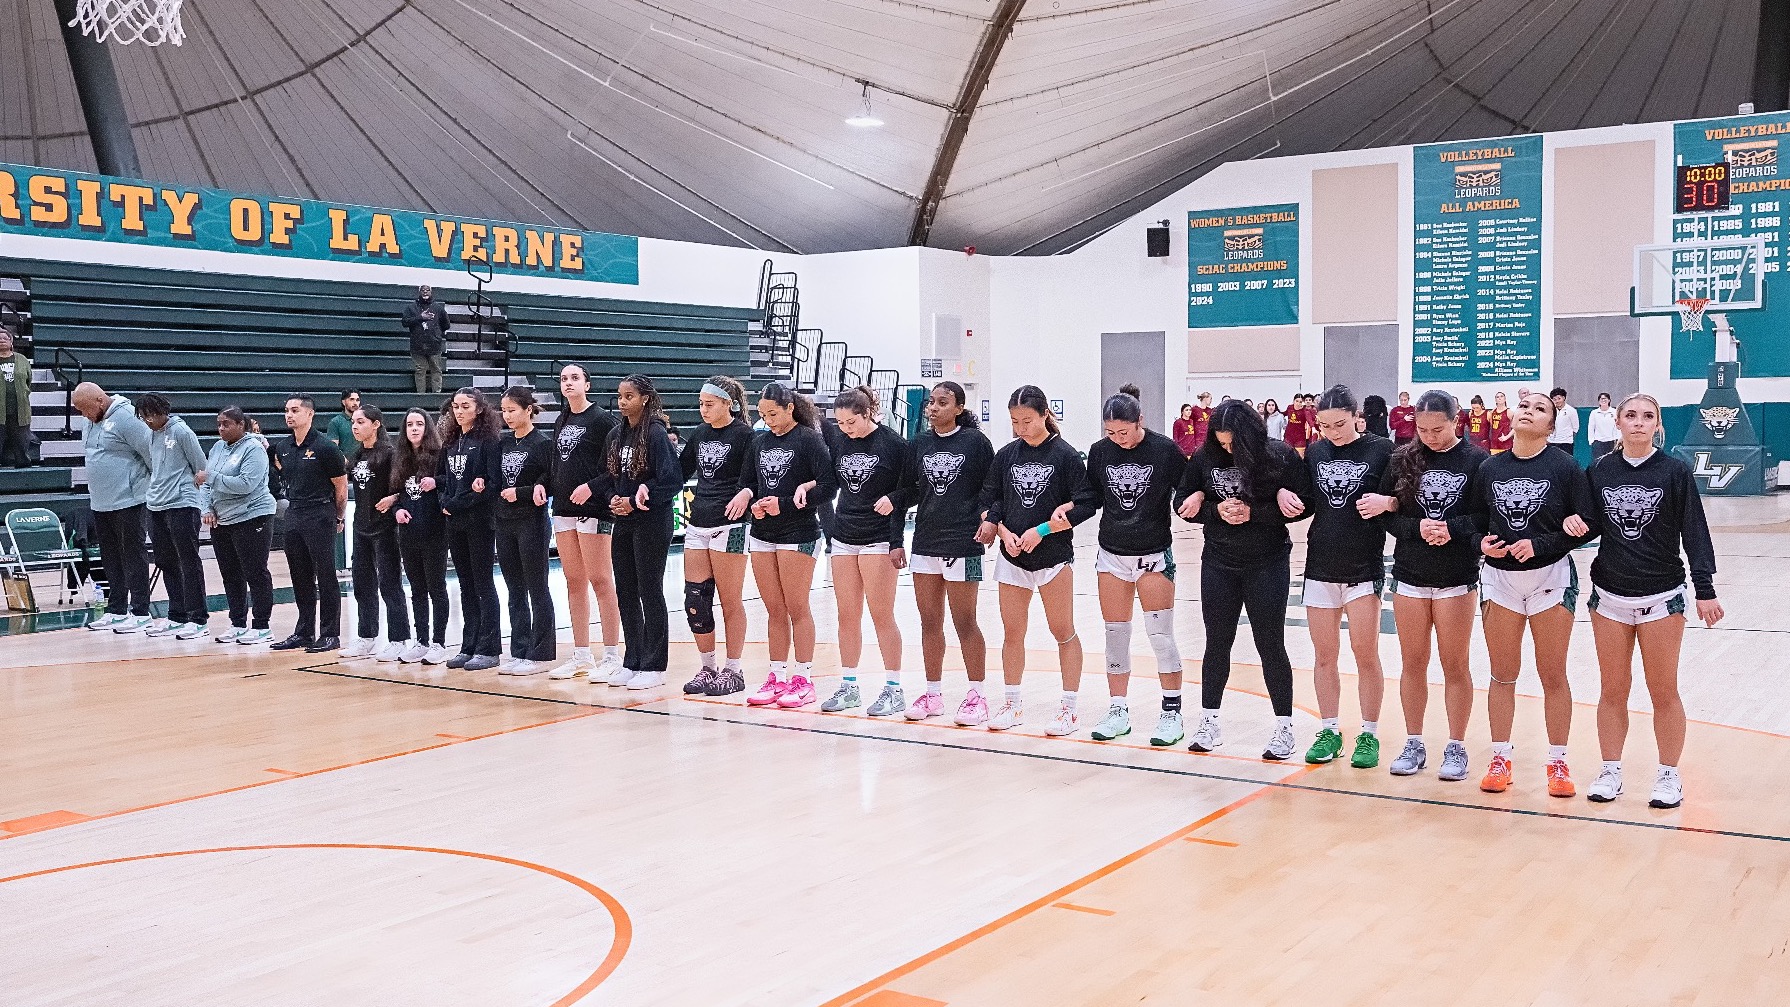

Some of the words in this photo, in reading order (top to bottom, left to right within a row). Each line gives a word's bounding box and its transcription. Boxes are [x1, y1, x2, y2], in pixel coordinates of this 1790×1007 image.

[1440, 147, 1515, 163] VOLLEYBALL
[1687, 167, 1725, 182] 10:00
[1731, 165, 1777, 178] EOPARDS
[1455, 186, 1500, 198] LEOPARDS
[1683, 182, 1718, 208] 30
[1440, 203, 1463, 213] ALL
[1466, 198, 1521, 211] AMERICA
[1751, 201, 1780, 213] 1981
[1190, 216, 1233, 228] WOMEN'S
[1236, 212, 1296, 225] BASKETBALL
[1713, 219, 1742, 230] 1985
[230, 197, 302, 247] OF
[329, 208, 401, 255] LA
[424, 219, 585, 270] VERNE
[1224, 250, 1264, 260] LEOPARDS
[1712, 249, 1742, 260] 2000
[1749, 247, 1779, 258] 201
[1197, 264, 1226, 274] SCIAC
[1228, 260, 1287, 273] CHAMPIONS
[1749, 262, 1780, 273] 205
[1190, 284, 1212, 292] 1990
[1218, 282, 1240, 292] 2003
[1244, 280, 1268, 290] 2007
[1272, 278, 1296, 288] 2023
[1190, 296, 1214, 306] 2024
[1693, 452, 1744, 489] LV
